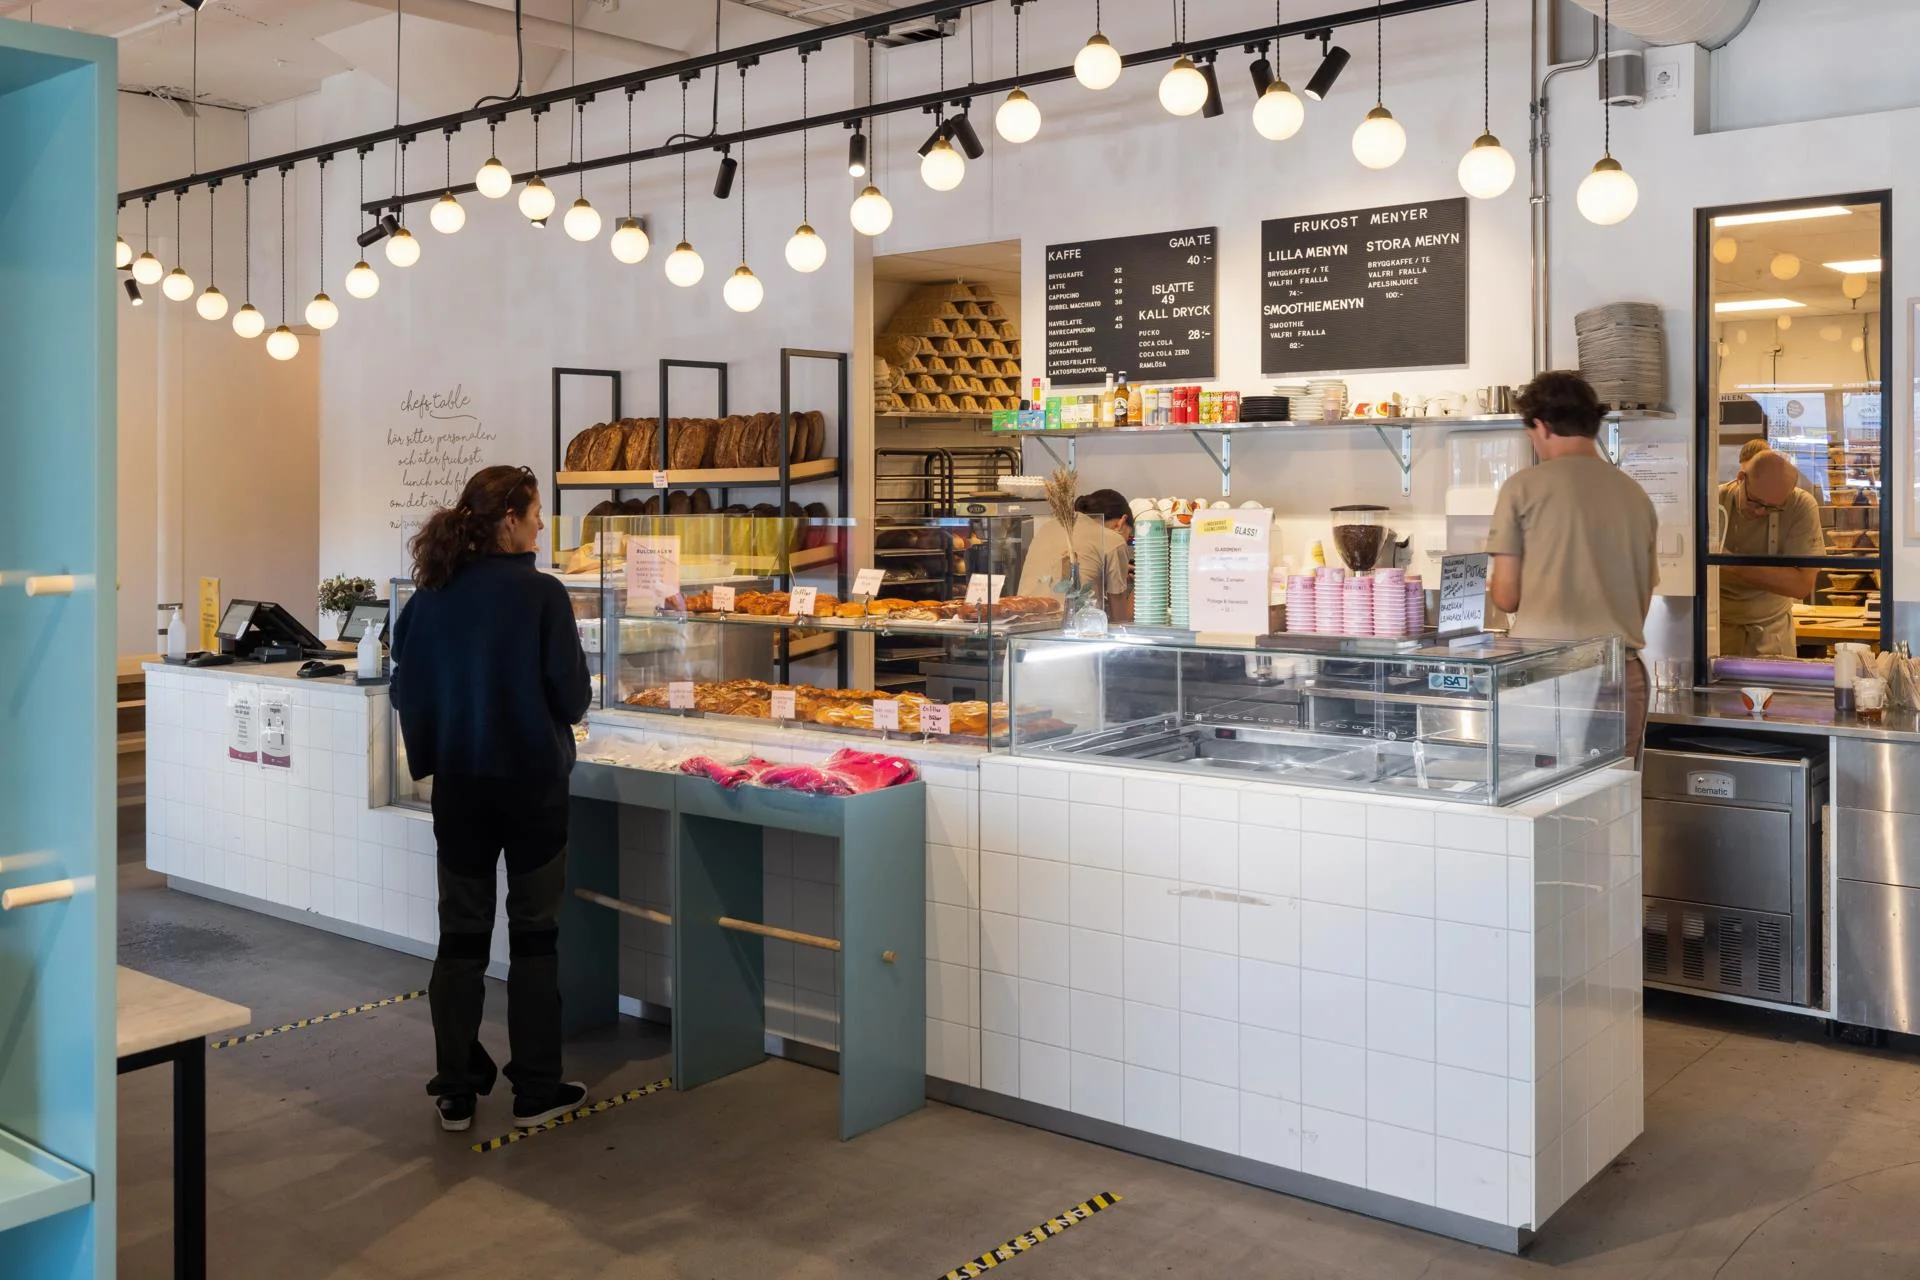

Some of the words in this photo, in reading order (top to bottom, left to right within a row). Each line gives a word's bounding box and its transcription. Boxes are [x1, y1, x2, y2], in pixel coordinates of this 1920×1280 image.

[1294, 216, 1358, 233] FRUKOST
[1370, 208, 1428, 224] MENYER
[1169, 236, 1196, 248] GAIA
[1197, 234, 1211, 245] TE
[1366, 237, 1411, 252] STORA
[1414, 232, 1460, 247] MENYN
[1048, 249, 1081, 260] KAFFE
[1269, 248, 1303, 262] LILLA
[1306, 244, 1348, 258] MENYN
[1368, 258, 1413, 269] BRYGGKAFFE
[1267, 268, 1310, 278] BRYGGKAFFE
[1368, 270, 1393, 278] VALFRI
[1399, 267, 1427, 275] FRALLA
[1300, 276, 1328, 284] FRALLA
[1368, 278, 1419, 289] APELSINJUICE
[1152, 282, 1194, 295] ISLATTE
[1161, 294, 1175, 304] 49
[1070, 301, 1102, 309] MACCHIATO
[1264, 298, 1364, 316] SMOOTHIEMENYN
[1139, 308, 1168, 320] KALL
[1173, 305, 1211, 318] DRYCK
[1048, 318, 1083, 327] HAVRELATTE
[1269, 321, 1304, 329] SMOOTHIE
[1048, 327, 1096, 336] HAVRECAPPUCINO
[1048, 346, 1092, 355] SOYACAPPUCINO
[1048, 358, 1096, 366] LAKTOSFRILATTE
[1139, 360, 1166, 369] RAMLÖSA
[1048, 367, 1107, 375] LAKTOSFRICAPPUCINO
[406, 427, 434, 447] sitter
[436, 422, 496, 452] personalen
[1235, 526, 1258, 537] GLASS!
[1695, 785, 1728, 795] Icematic
